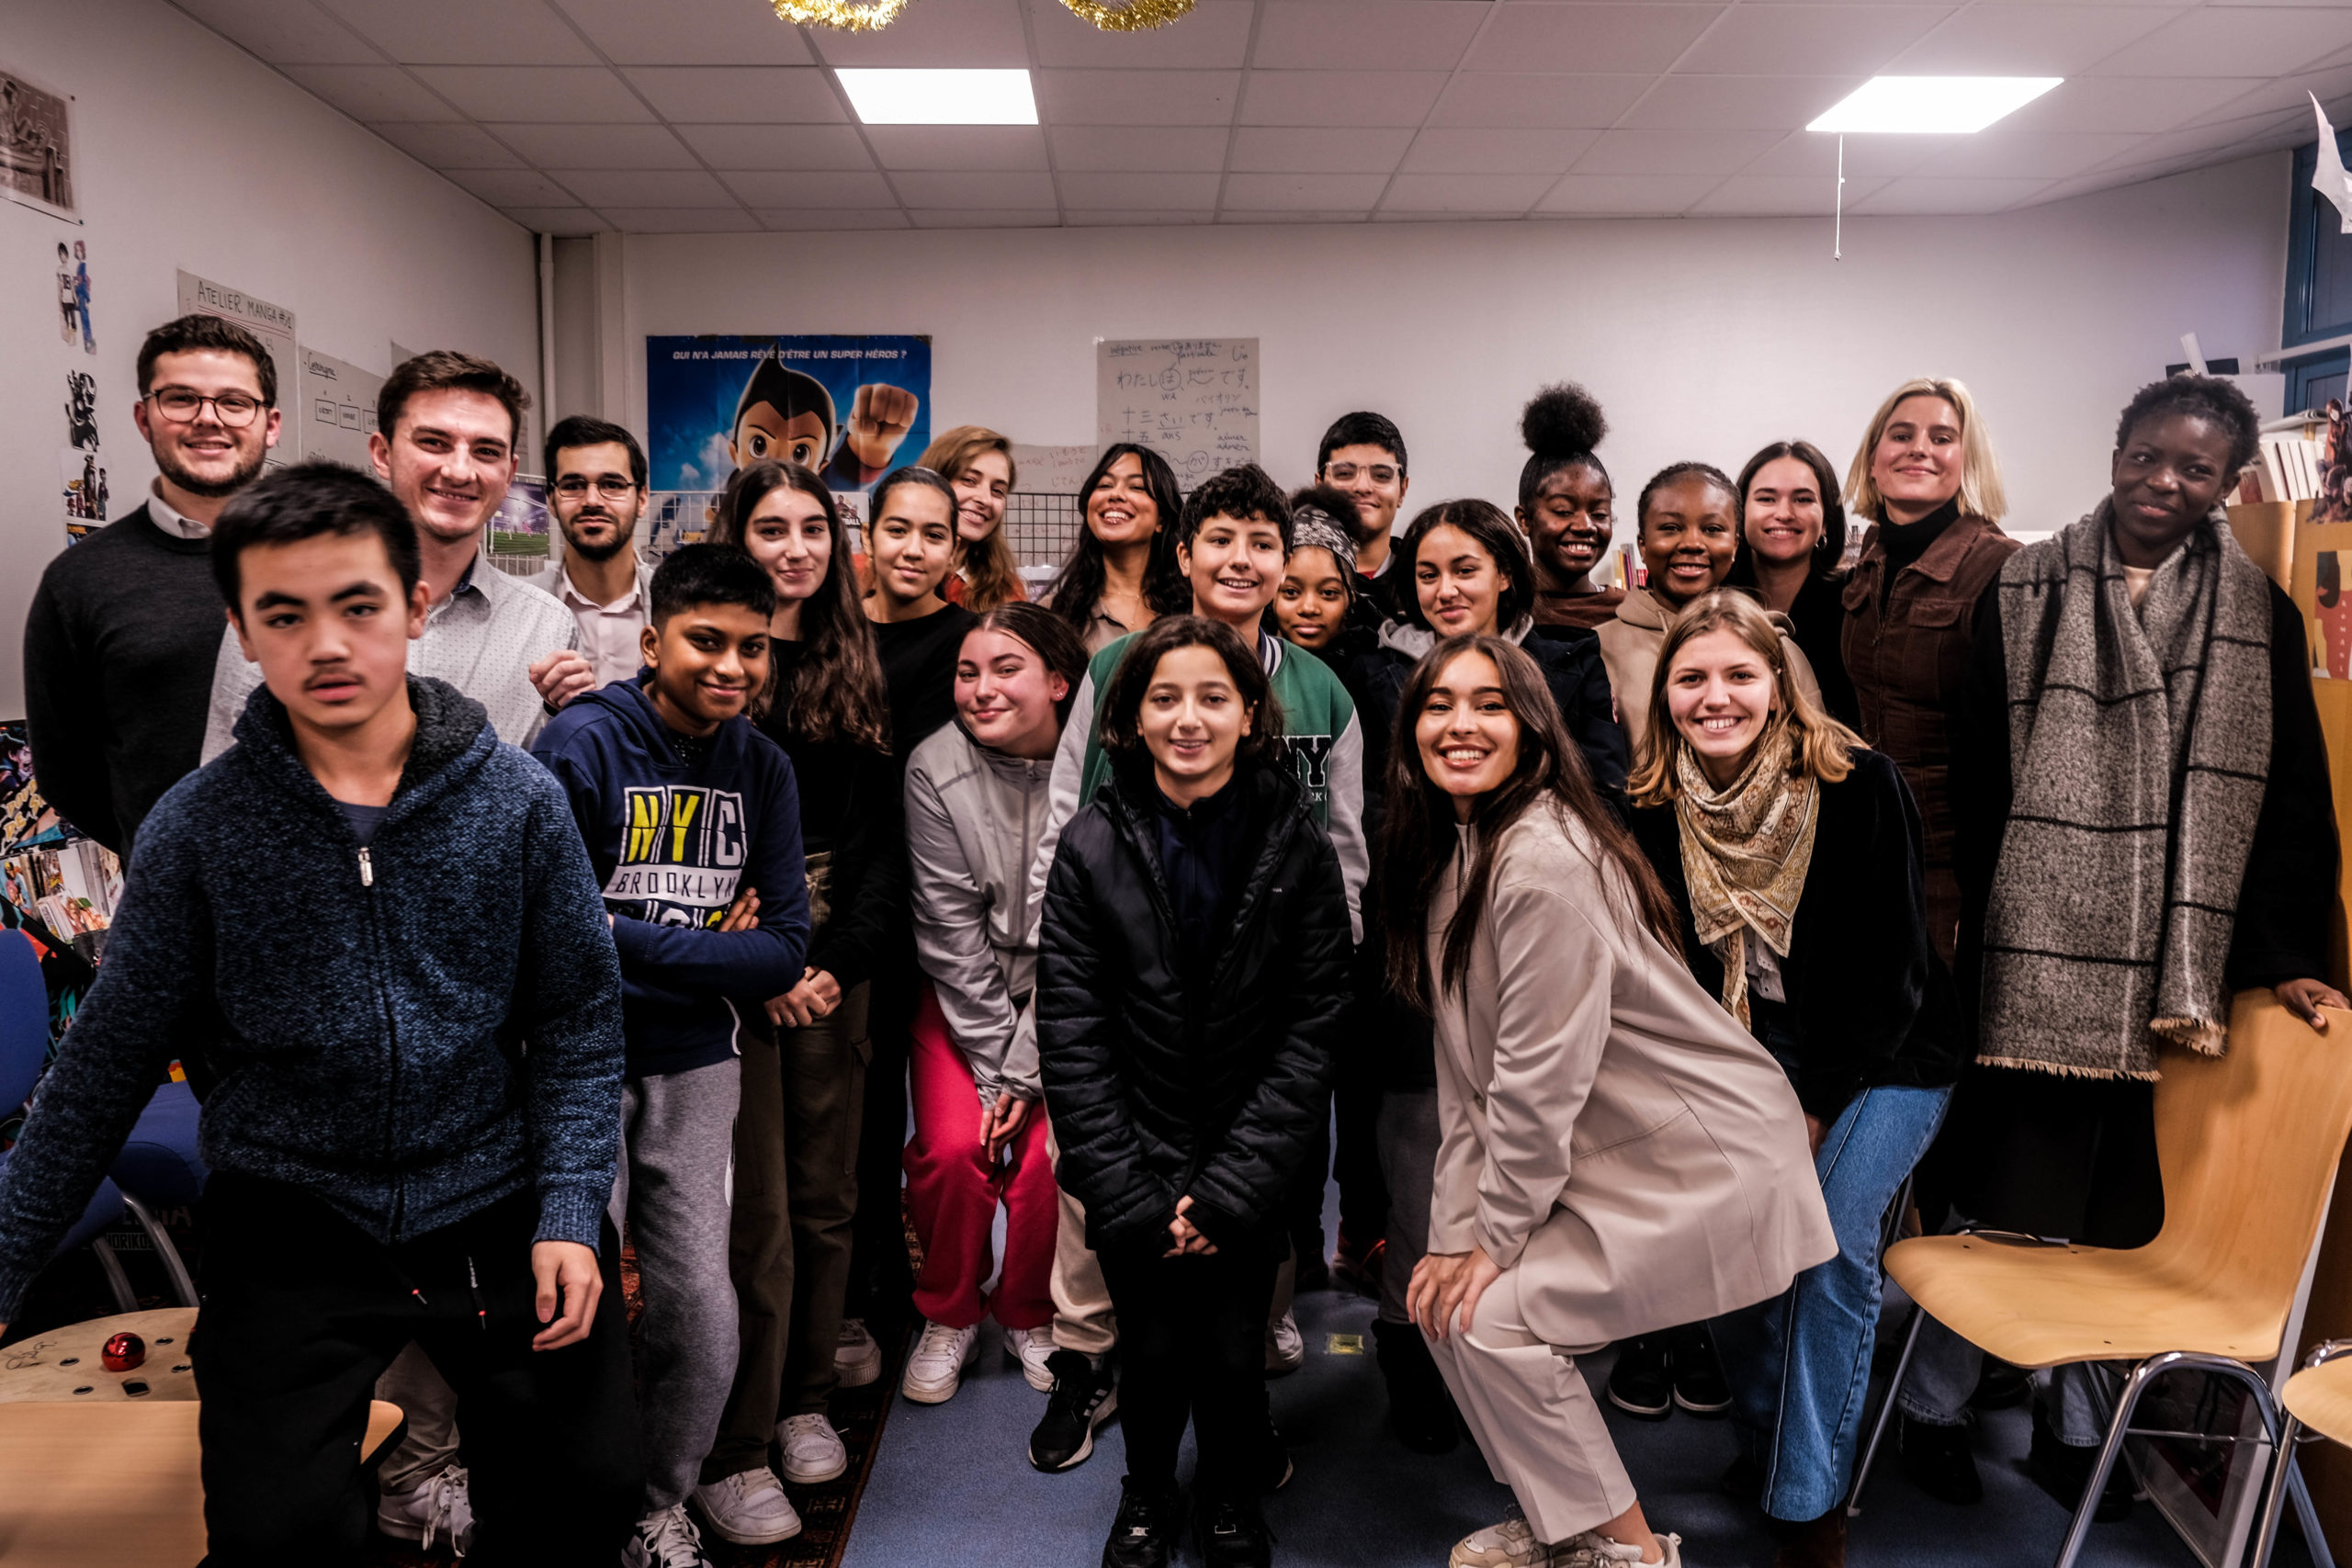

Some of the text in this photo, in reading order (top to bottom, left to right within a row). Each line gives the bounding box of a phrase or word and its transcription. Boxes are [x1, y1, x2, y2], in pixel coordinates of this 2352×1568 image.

[246, 299, 278, 325] MANGA
[673, 351, 690, 360] QUI
[692, 351, 709, 360] N'A
[710, 351, 749, 360] JAMAIS
[778, 348, 810, 359] D'ÊTRE
[812, 351, 829, 359] UN
[830, 351, 864, 359] SUPER
[865, 348, 899, 359] HÉROS
[899, 350, 908, 359] ?
[1161, 432, 1182, 441] ans
[627, 794, 743, 866] NYC
[616, 872, 737, 899] BROOKLYN
